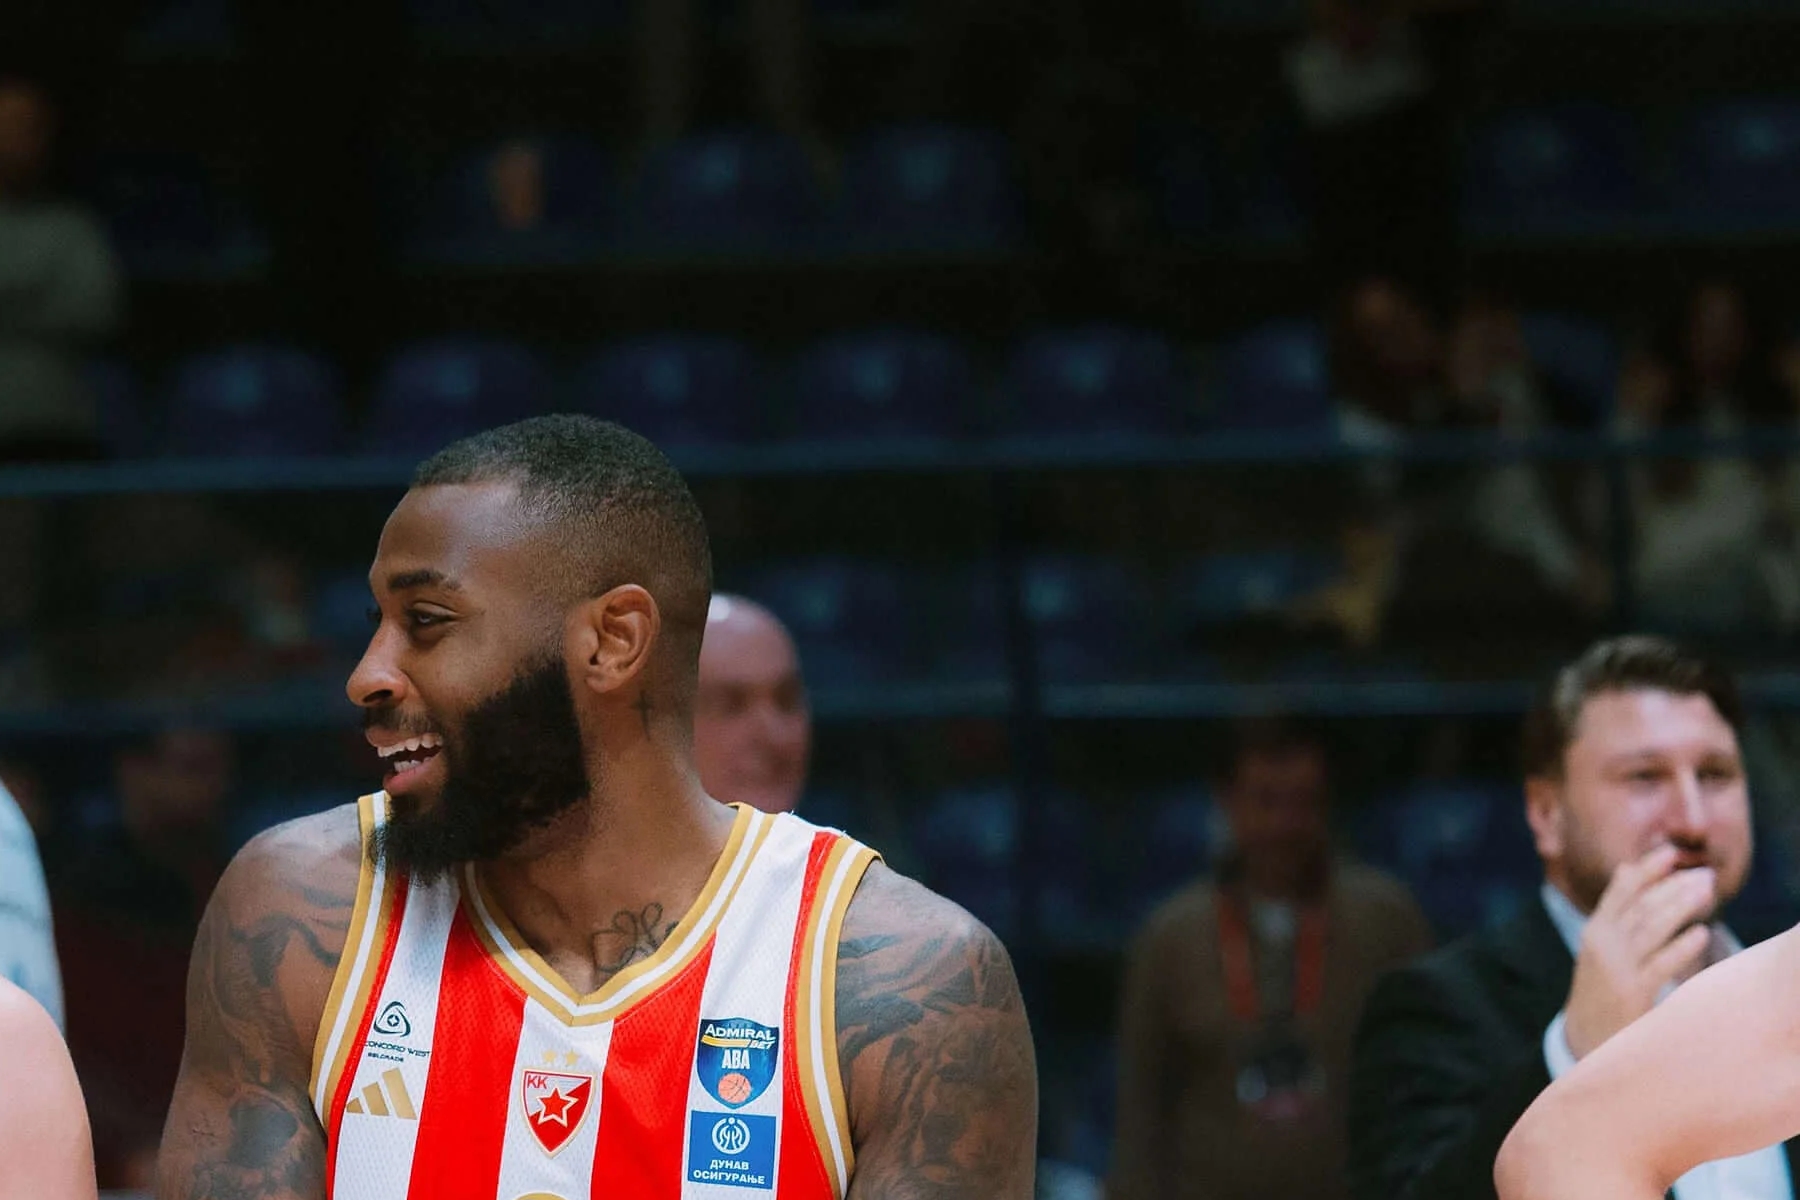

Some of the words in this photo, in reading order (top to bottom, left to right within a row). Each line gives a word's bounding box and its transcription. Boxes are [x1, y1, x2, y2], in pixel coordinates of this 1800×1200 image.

[704, 1024, 776, 1041] ADMIRAL
[750, 1039, 776, 1050] BET
[721, 1050, 750, 1070] ABA
[527, 1075, 548, 1090] KK
[709, 1159, 749, 1171] ДУНАВ
[693, 1169, 766, 1185] ОСИГУРАЊЕ
